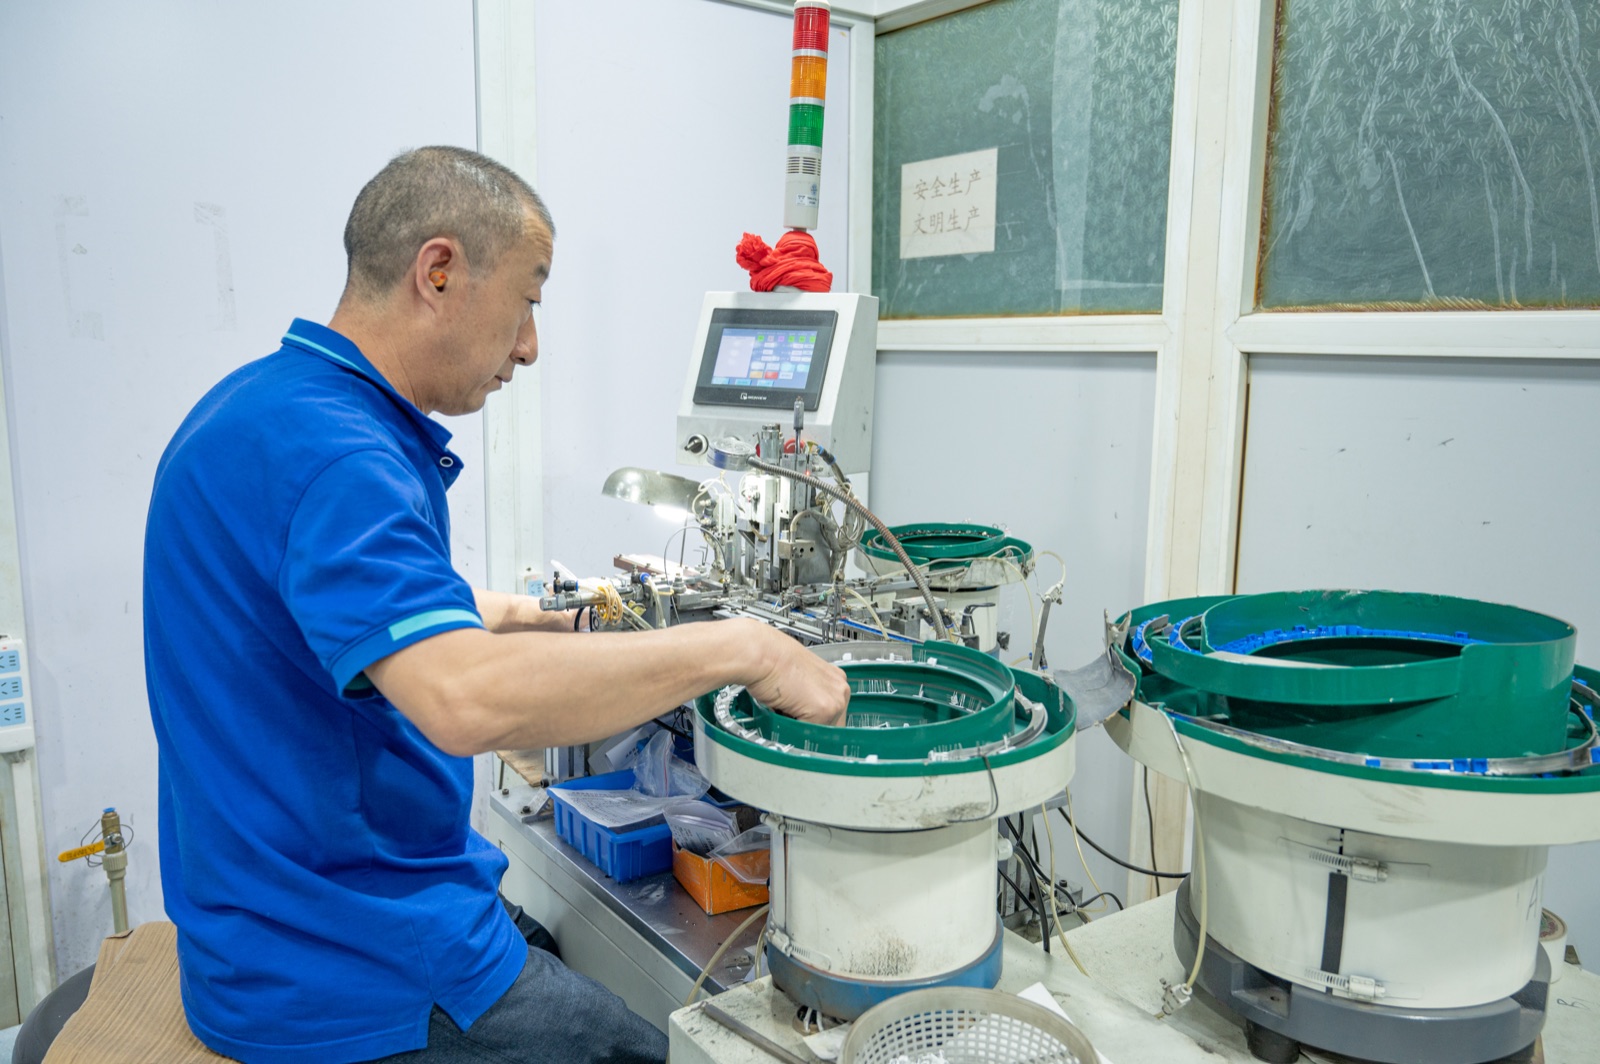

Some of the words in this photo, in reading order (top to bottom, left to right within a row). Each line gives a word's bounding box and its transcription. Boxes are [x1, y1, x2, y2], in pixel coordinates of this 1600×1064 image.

[913, 169, 981, 201] 安全生产
[914, 206, 980, 234] 文明生产
